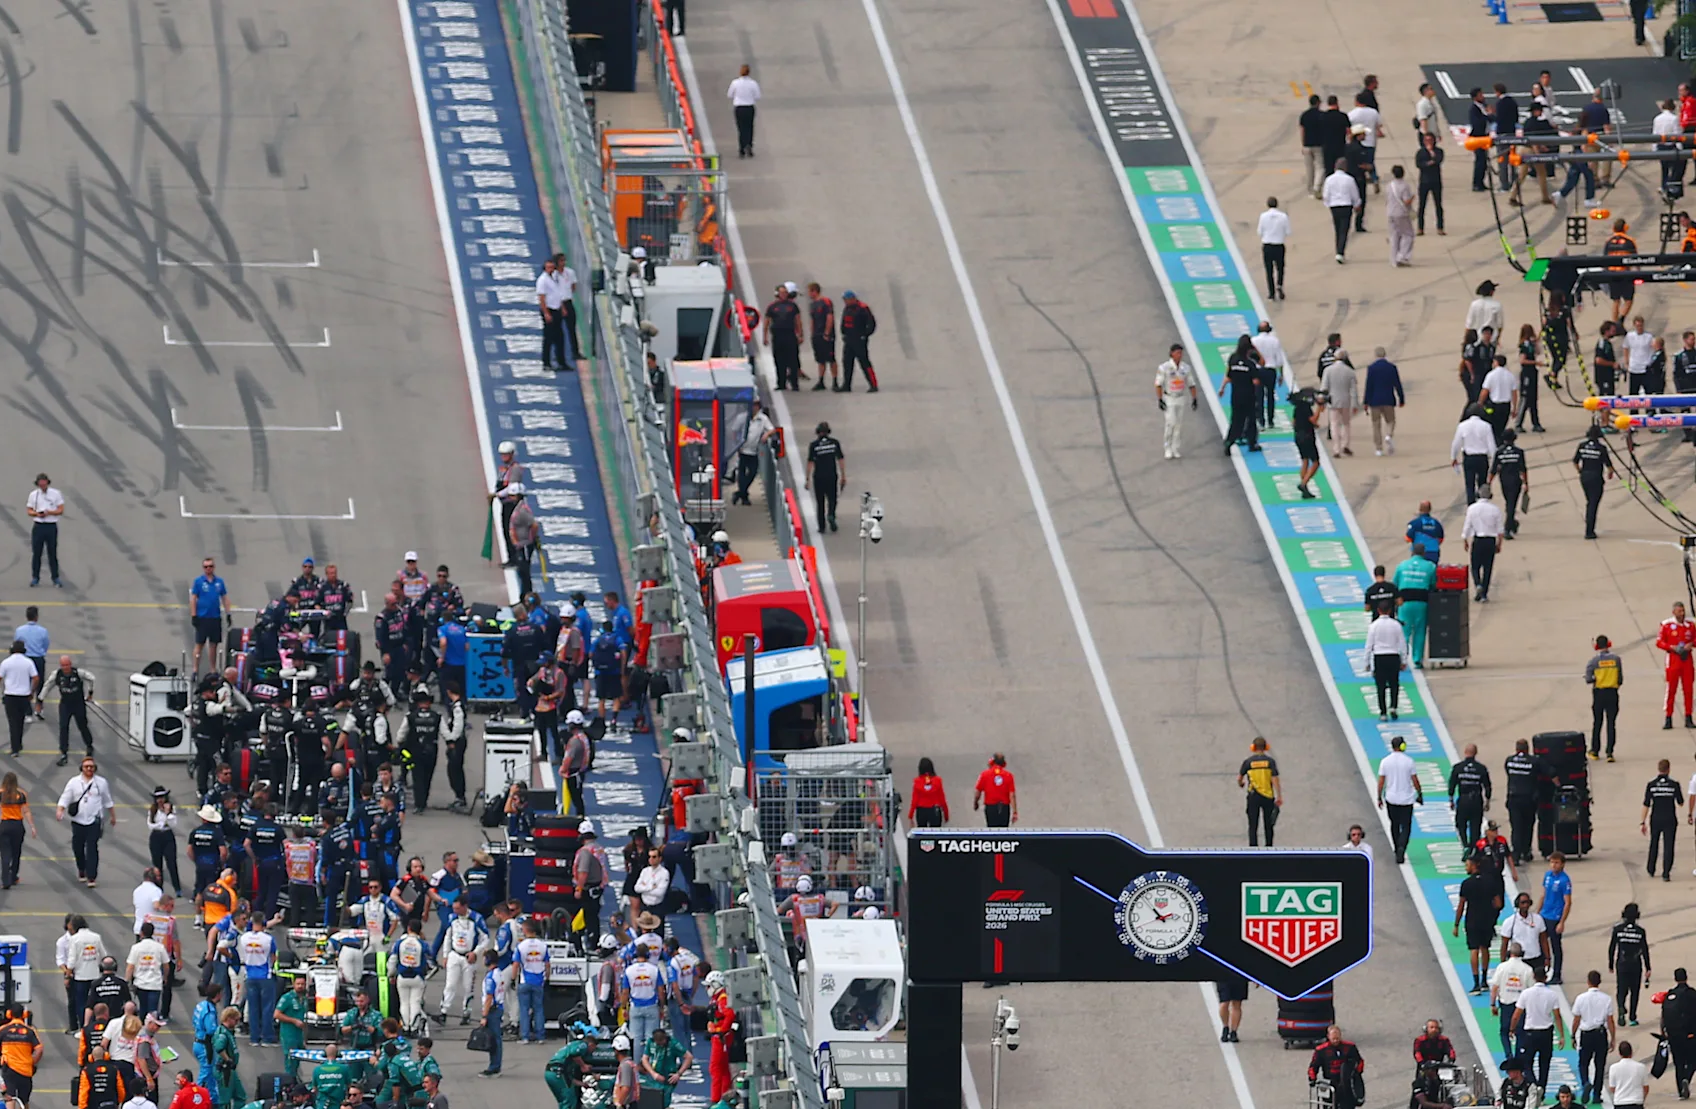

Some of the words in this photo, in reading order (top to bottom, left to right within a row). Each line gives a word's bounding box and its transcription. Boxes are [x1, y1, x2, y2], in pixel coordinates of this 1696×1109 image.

[1134, 876, 1146, 887] 55
[1177, 876, 1189, 887] 05
[1195, 890, 1204, 902] 10
[1249, 888, 1334, 914] TAG
[1247, 917, 1336, 958] HEUER
